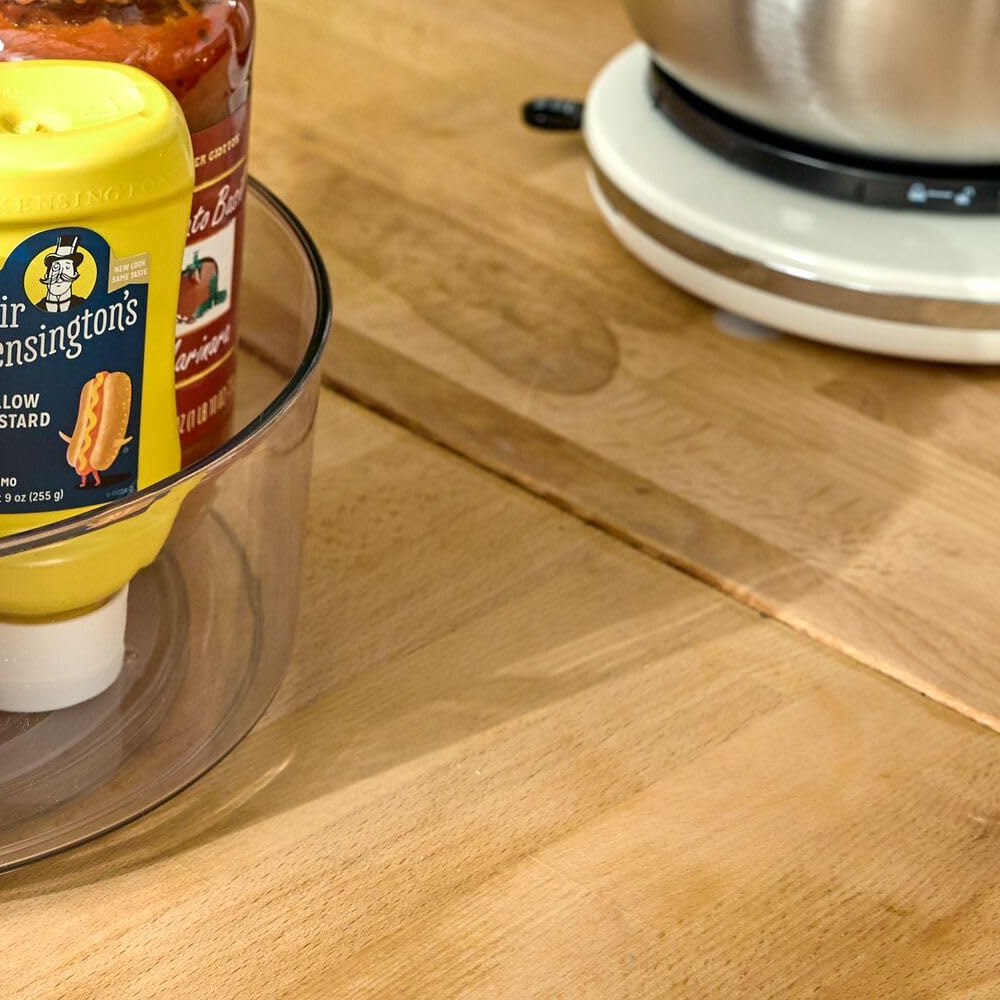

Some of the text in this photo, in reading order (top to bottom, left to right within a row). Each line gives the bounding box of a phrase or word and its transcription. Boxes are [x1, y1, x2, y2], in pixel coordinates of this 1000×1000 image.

[112, 268, 148, 284] SAME TASTE
[114, 263, 130, 274] NEW
[4, 493, 12, 503] 9
[14, 494, 27, 503] oz
[29, 491, 51, 504] (255
[53, 489, 64, 504] g)
